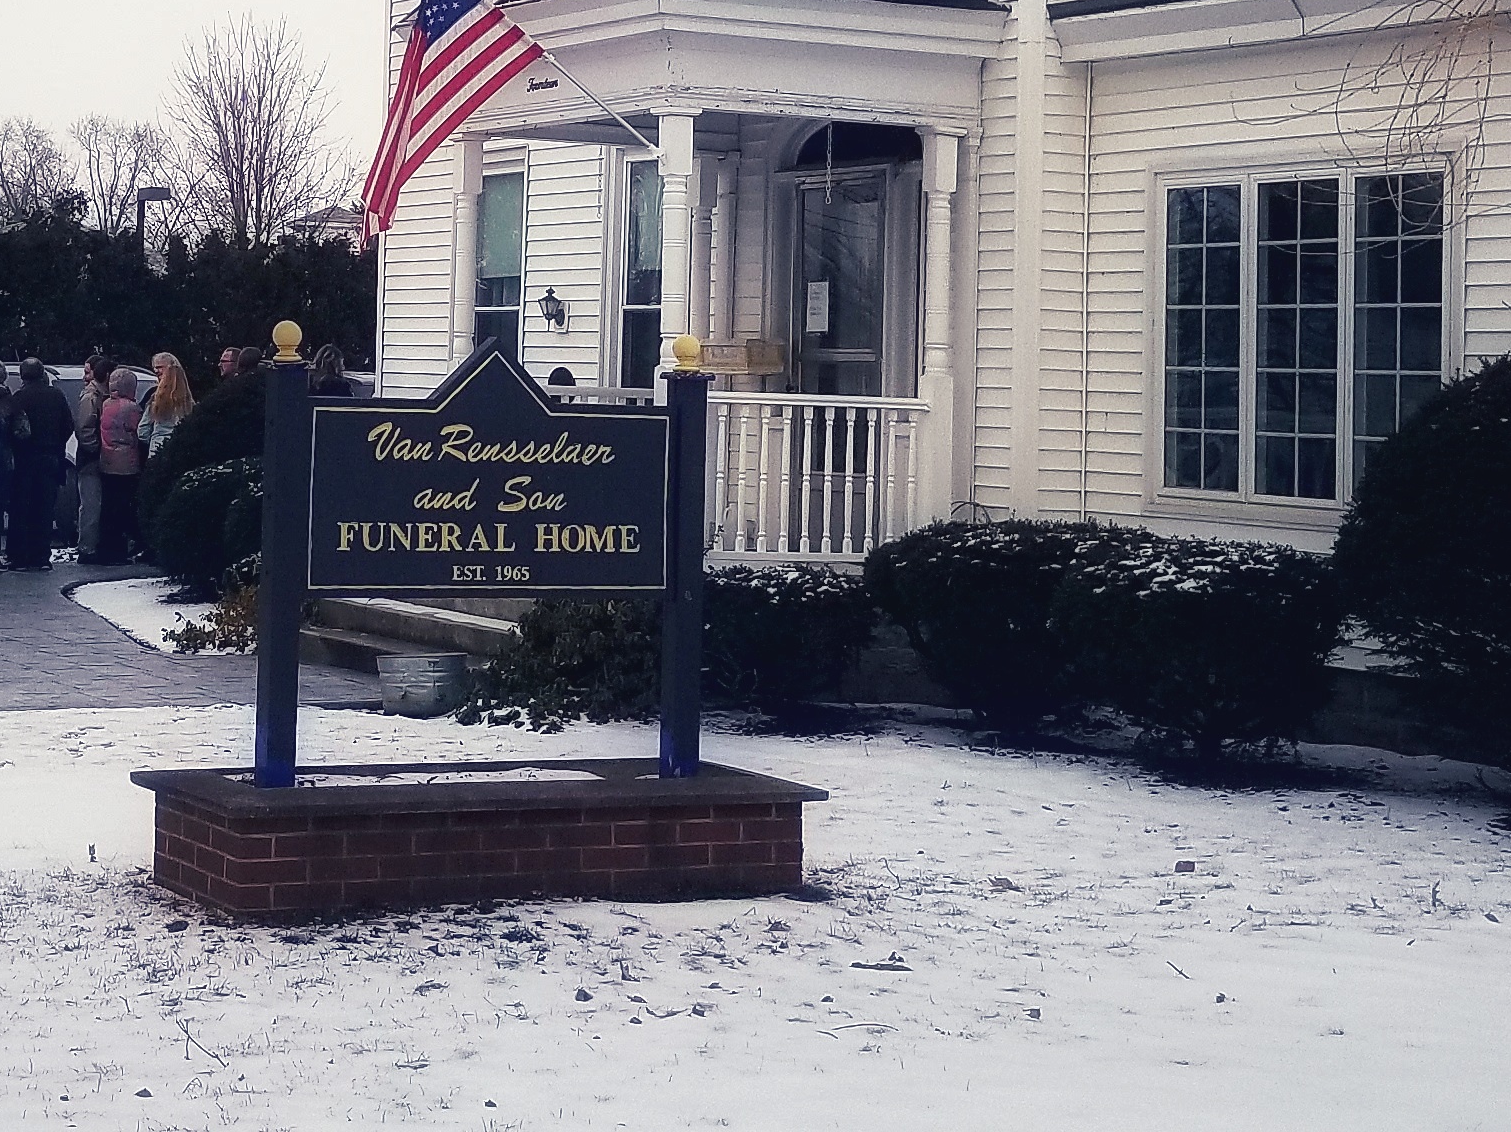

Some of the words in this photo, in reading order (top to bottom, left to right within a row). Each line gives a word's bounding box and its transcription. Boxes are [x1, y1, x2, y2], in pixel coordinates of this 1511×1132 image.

[367, 421, 435, 461] Van
[438, 423, 616, 466] Rensselaer
[413, 477, 480, 510] and
[497, 475, 568, 512] Son
[336, 521, 516, 552] FUNERAL
[533, 523, 641, 553] HOME
[451, 565, 487, 581] EST.
[494, 565, 531, 581] 1965
